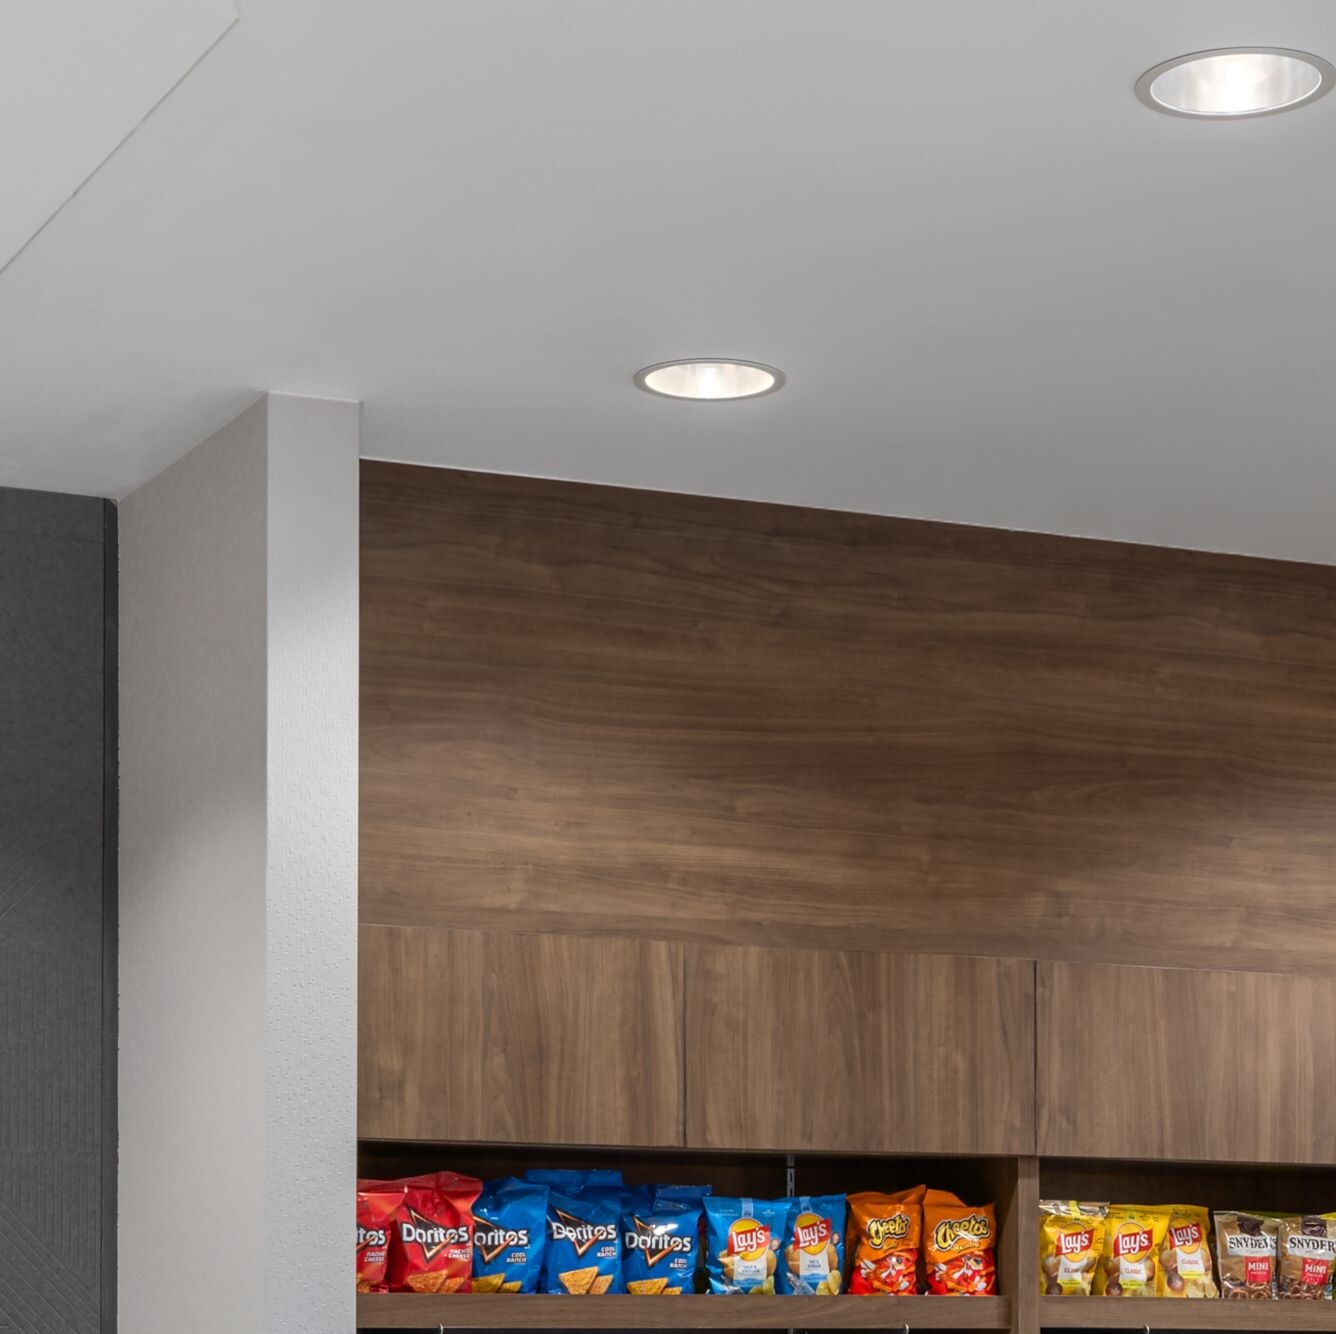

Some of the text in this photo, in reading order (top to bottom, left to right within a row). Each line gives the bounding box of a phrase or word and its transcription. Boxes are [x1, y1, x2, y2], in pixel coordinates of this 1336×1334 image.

[402, 1222, 469, 1243] Doritos
[474, 1228, 528, 1246] oritos
[551, 1221, 617, 1242] Doritos
[625, 1232, 691, 1252] Doritos
[732, 1227, 766, 1252] Lay's
[798, 1221, 827, 1247] Lay's
[934, 1215, 990, 1250] Cheetos
[1170, 1223, 1199, 1247] Lay's
[1060, 1231, 1089, 1254] Lay's
[1119, 1231, 1149, 1254] Lay's
[1289, 1236, 1336, 1254] SNYDER
[1247, 1262, 1269, 1271] MINI
[1305, 1263, 1327, 1274] MINI
